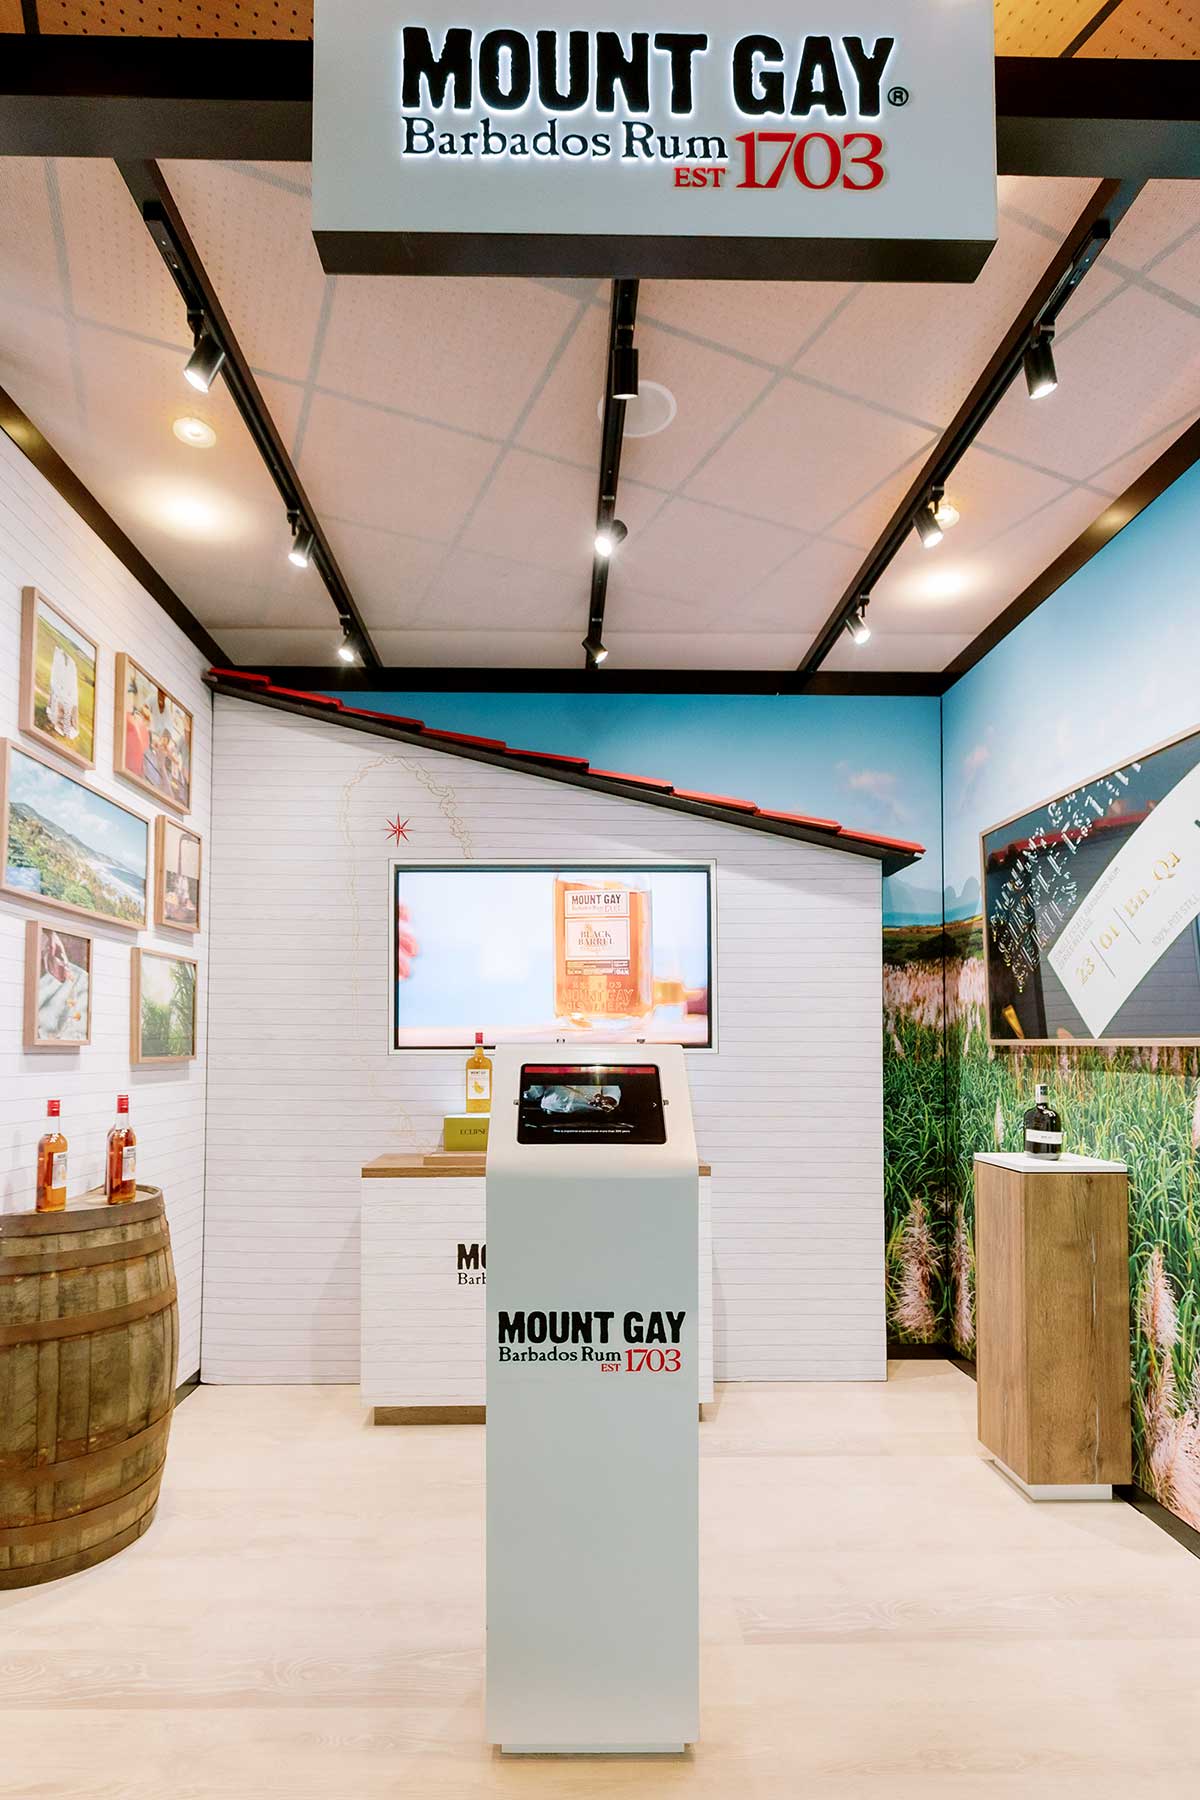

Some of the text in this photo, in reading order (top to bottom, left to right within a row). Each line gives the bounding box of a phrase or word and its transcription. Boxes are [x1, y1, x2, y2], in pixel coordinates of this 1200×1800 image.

[401, 26, 708, 116] MOUNT
[732, 34, 895, 118] GAY
[402, 116, 729, 161] Barbados Rum
[673, 132, 886, 191] EST 1703
[571, 894, 621, 905] MOUNT GAY
[498, 1311, 686, 1344] MOUNT GAY
[498, 1346, 622, 1362] Barbados Rum
[601, 1348, 682, 1373] EST 1703
